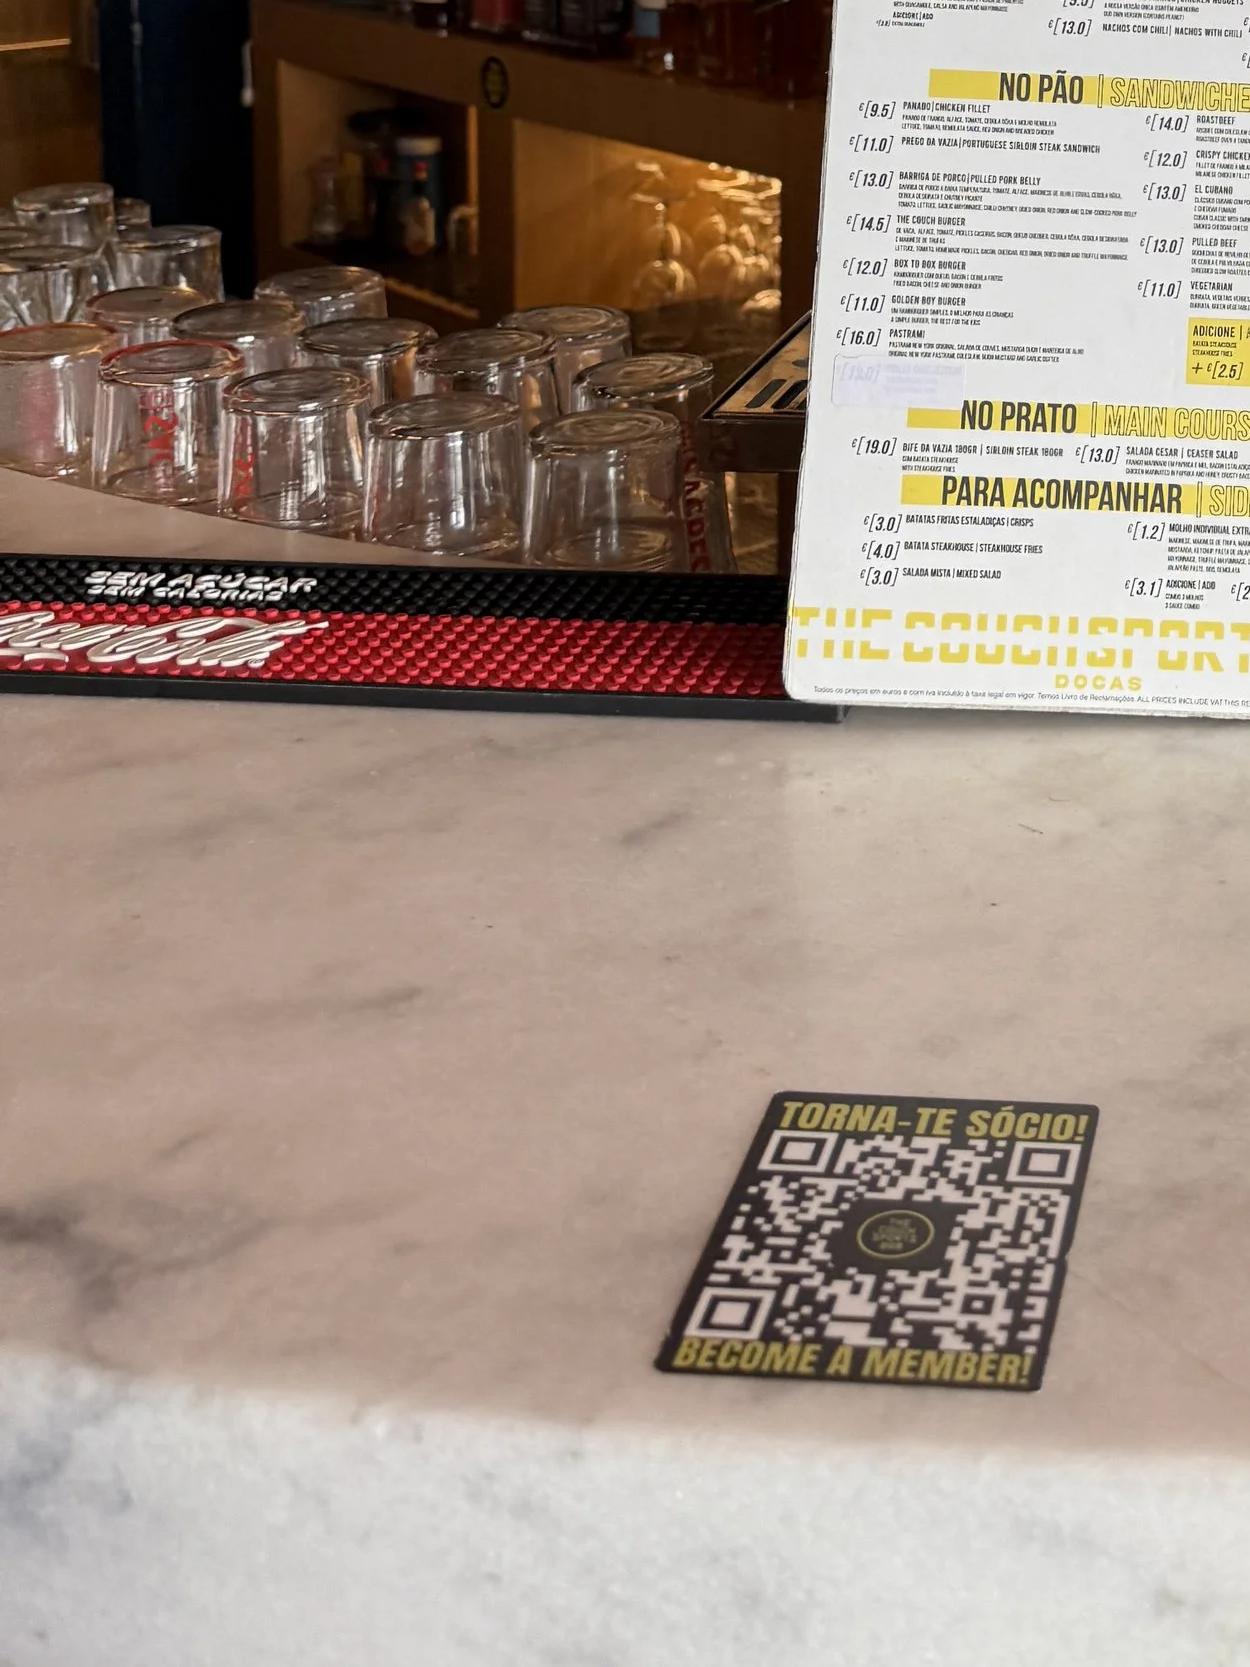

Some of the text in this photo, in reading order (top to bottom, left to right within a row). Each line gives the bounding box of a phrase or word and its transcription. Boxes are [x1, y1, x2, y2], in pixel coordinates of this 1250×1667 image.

[999, 72, 1030, 102] NO
[1038, 70, 1083, 104] PÃO
[1196, 114, 1234, 124] ROASTBEEF
[1196, 149, 1220, 159] CRISPY
[1194, 184, 1233, 194] EL CUBANO
[897, 214, 965, 226] THE COUCH BURGER
[1192, 237, 1236, 247] PULLED BEEF
[894, 258, 966, 270] BOX TO BOX BURGER
[1190, 280, 1232, 290] VEGETARIAN
[891, 294, 966, 306] GOLDEN BOY BURGER
[889, 328, 925, 338] PASTRAMI
[1193, 325, 1235, 338] ADICIONE
[961, 400, 993, 430] NO
[1001, 401, 1077, 434] PRATO
[1104, 404, 1167, 437] MAIN
[902, 442, 1063, 456] BIFE DA VAZIA 180GR SIRLOIN STEAK 180GR
[1126, 446, 1238, 459] SALADA CESAR CEASER SALAD
[942, 476, 1005, 508] PARA
[1012, 477, 1181, 513] ACOMPANHAR
[903, 540, 1042, 553] BATATA STEAKHOUSE STEAKHOUSE FRIES
[902, 567, 1001, 579] SALADA MISTA MIXED SALAD
[791, 606, 892, 659] THE
[1054, 674, 1143, 691] DOCAS
[779, 1101, 1089, 1142] TORNA-TE SÓCIO!
[672, 1337, 1033, 1385] BECOME A MEMBER!
